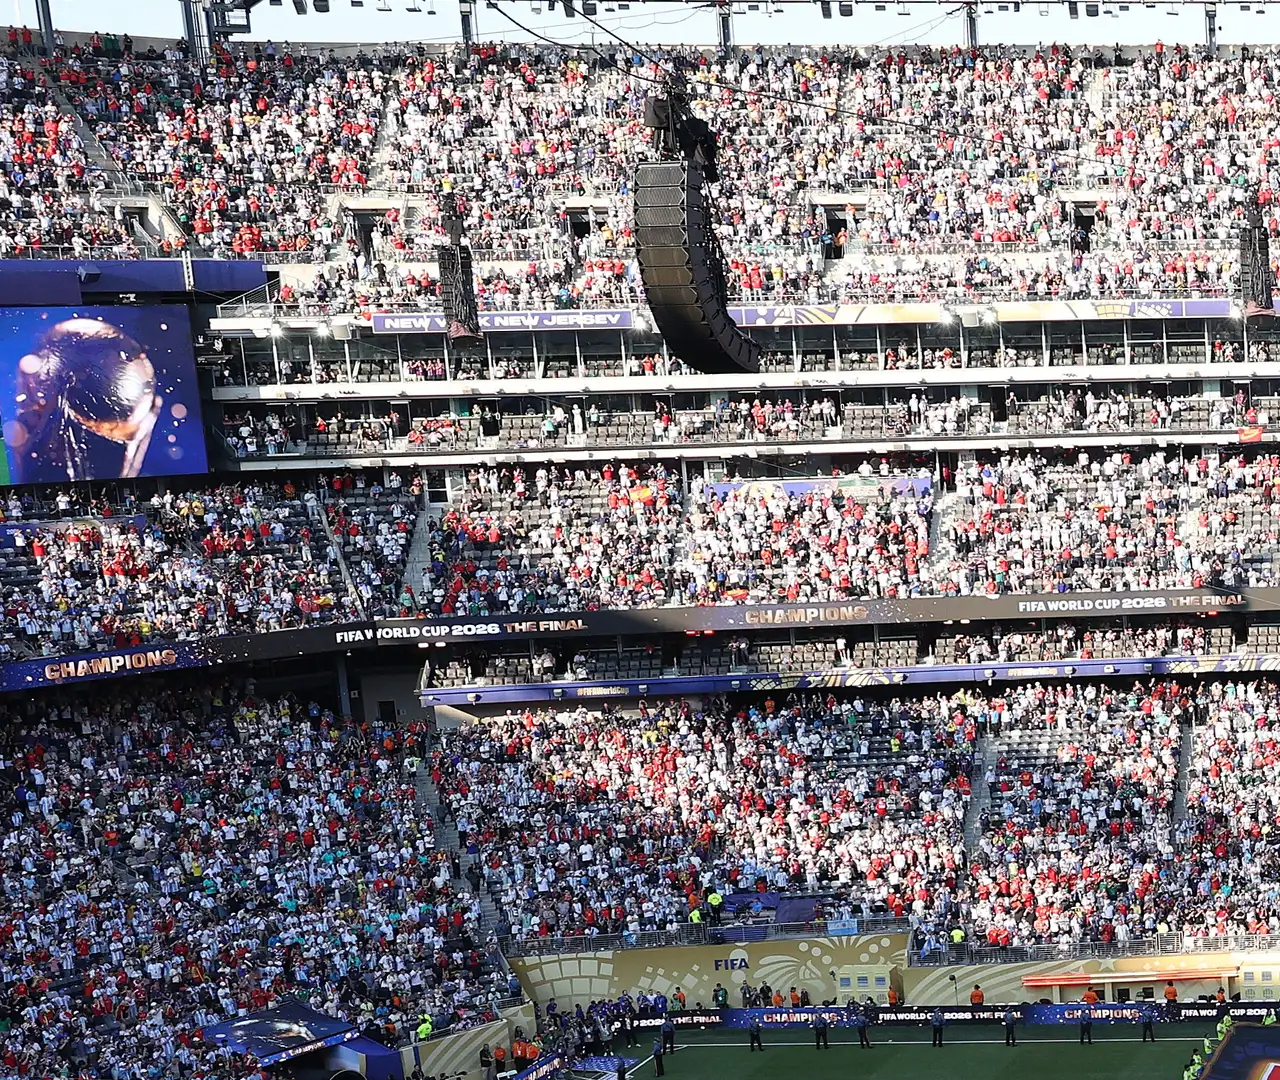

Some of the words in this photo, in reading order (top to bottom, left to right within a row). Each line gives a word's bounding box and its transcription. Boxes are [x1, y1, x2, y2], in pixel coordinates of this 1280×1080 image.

[385, 316, 432, 329] NEW
[494, 315, 539, 327] NEW
[543, 313, 621, 326] JERSEY
[1018, 601, 1044, 612] FIFA
[1046, 599, 1093, 611] WORLD
[1095, 598, 1120, 610] CUP
[1121, 597, 1167, 608] 2026
[1169, 596, 1200, 606] THE
[1202, 595, 1246, 605] FINAL
[745, 606, 869, 624] CHAMPIONS
[336, 629, 365, 642] FIFA
[422, 626, 449, 637] CUP
[450, 623, 499, 635] 2026
[503, 621, 537, 632] THE
[539, 619, 587, 631] FINAL
[45, 650, 176, 679] CHAMPIONS
[714, 958, 750, 971] FIFA
[671, 1016, 692, 1024] THE
[879, 1012, 897, 1020] FIFA
[897, 1012, 926, 1020] WORLD
